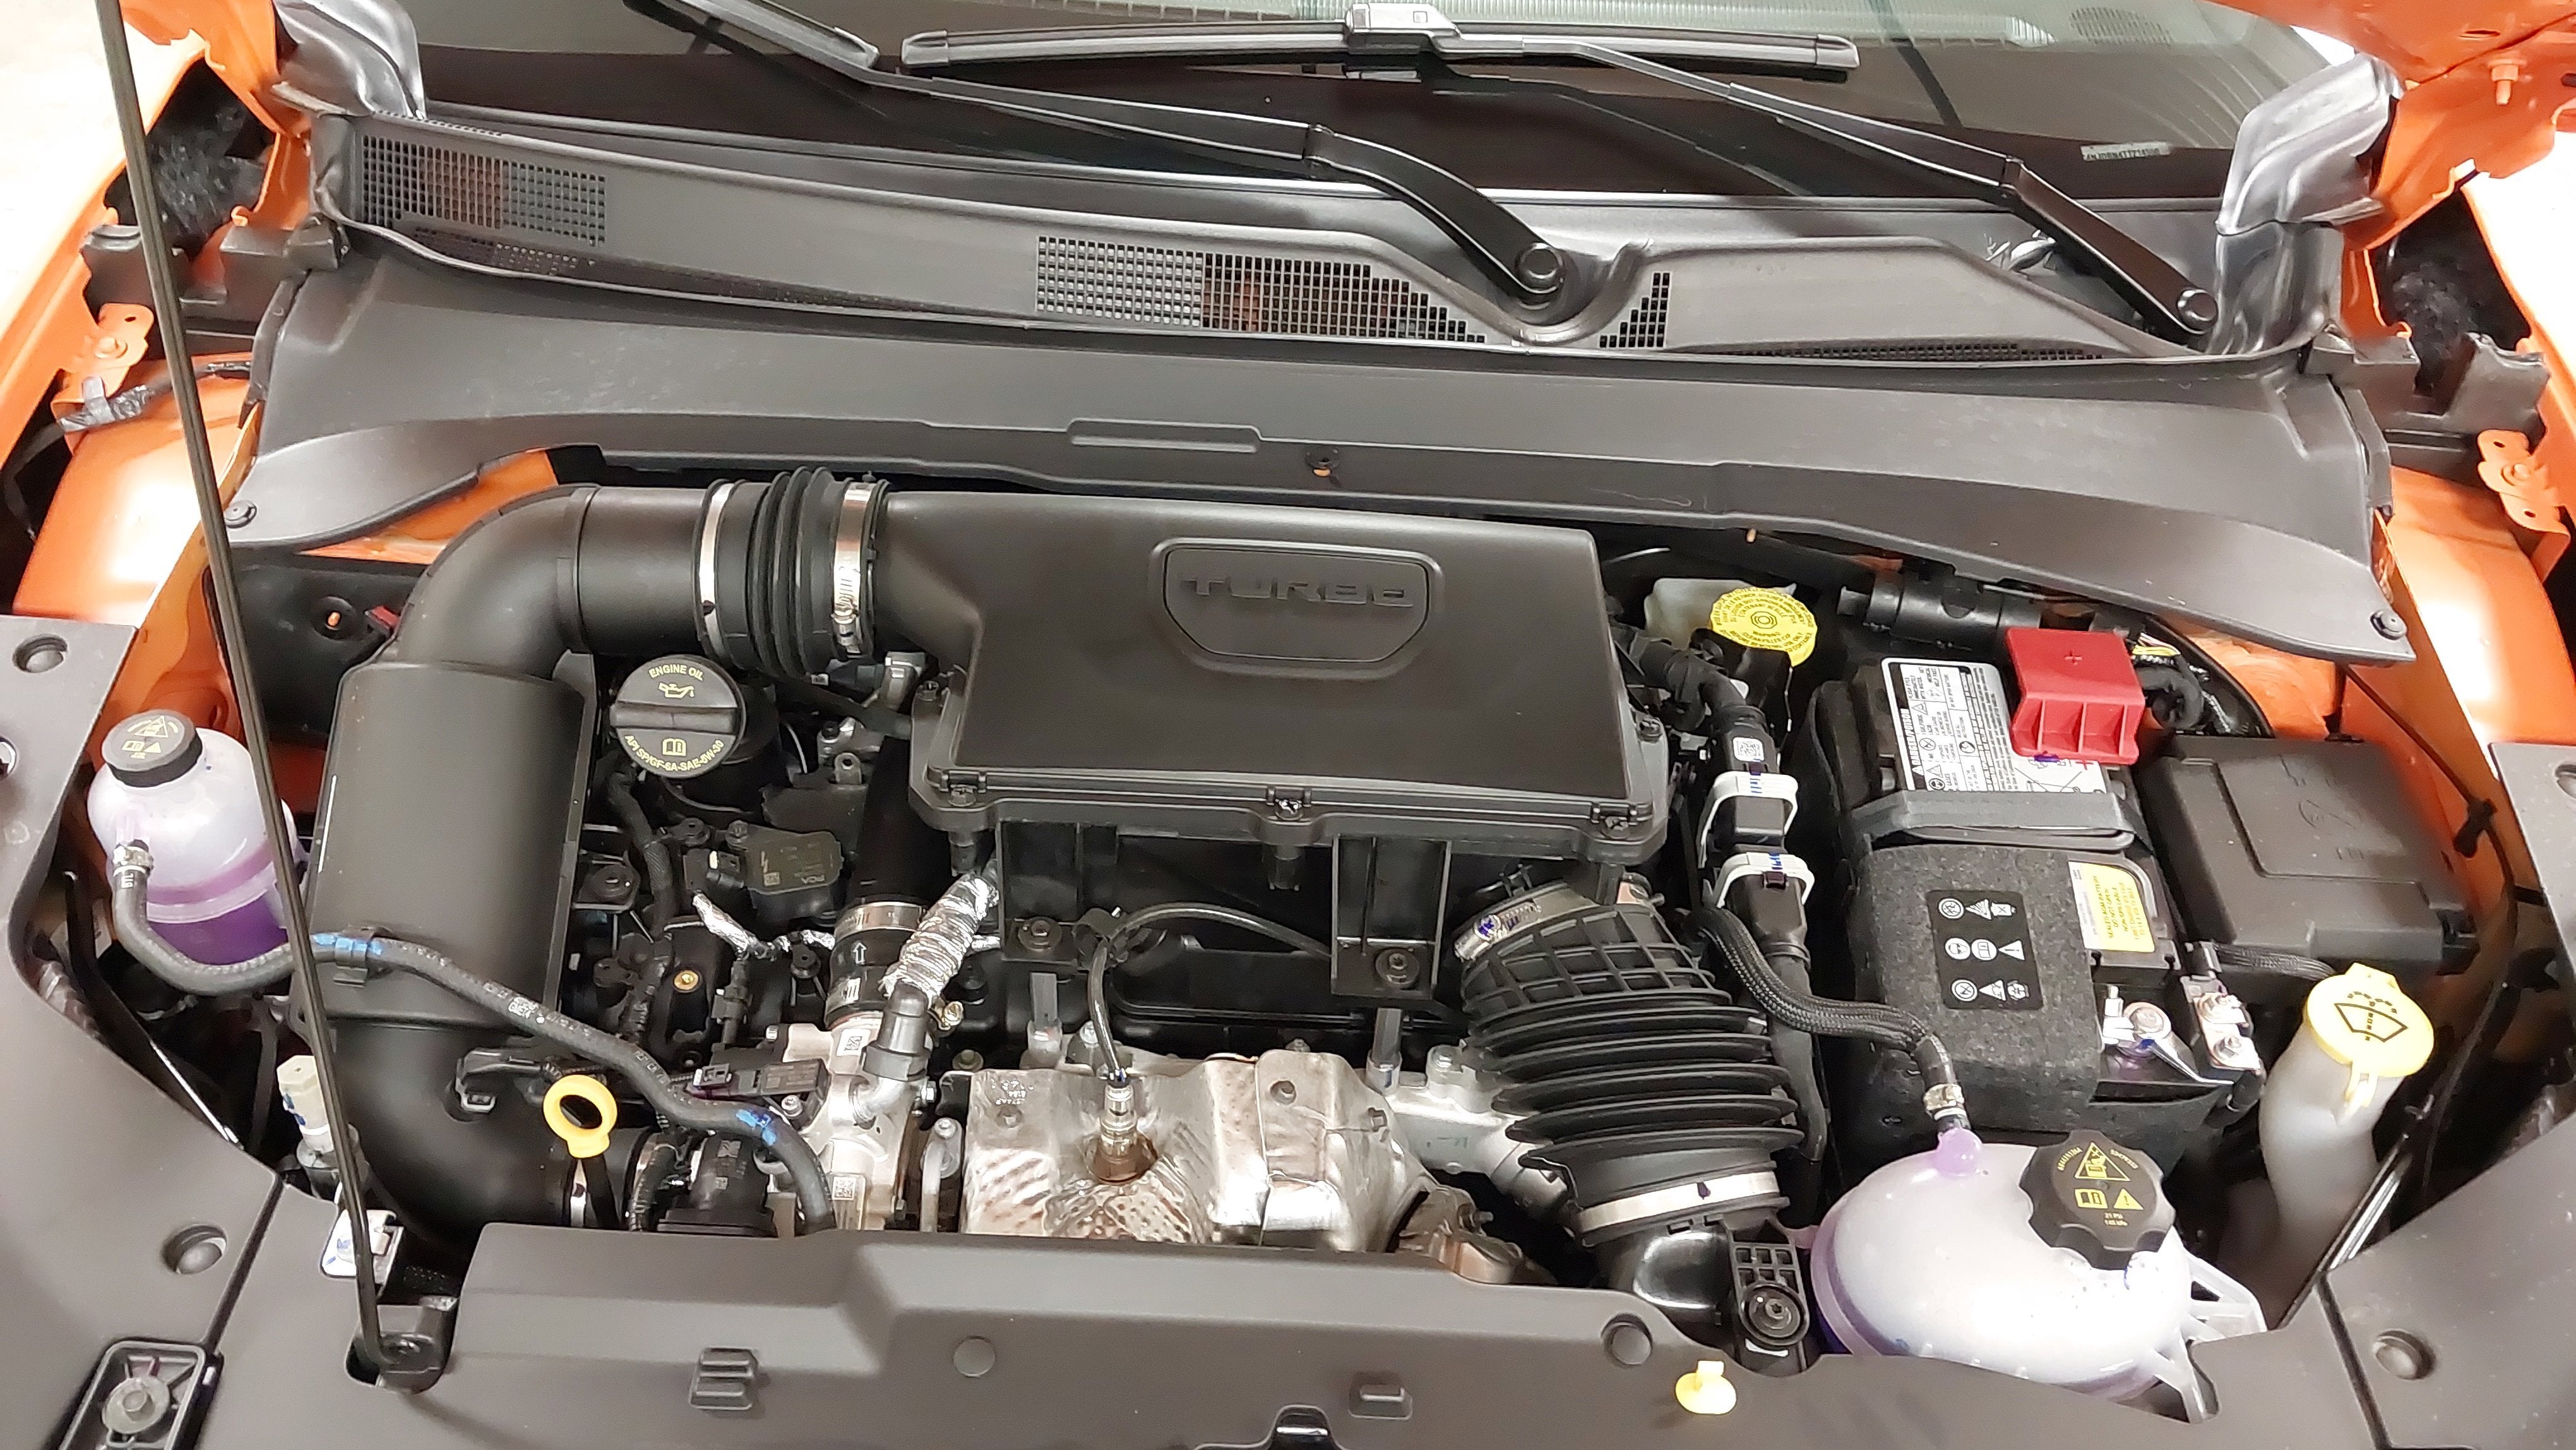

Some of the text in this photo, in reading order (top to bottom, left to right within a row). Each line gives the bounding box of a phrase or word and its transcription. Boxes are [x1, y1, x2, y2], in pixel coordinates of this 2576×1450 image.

[1180, 578, 1414, 608] TURBO
[649, 664, 705, 681] ENGINE OIL
[624, 734, 641, 751] API
